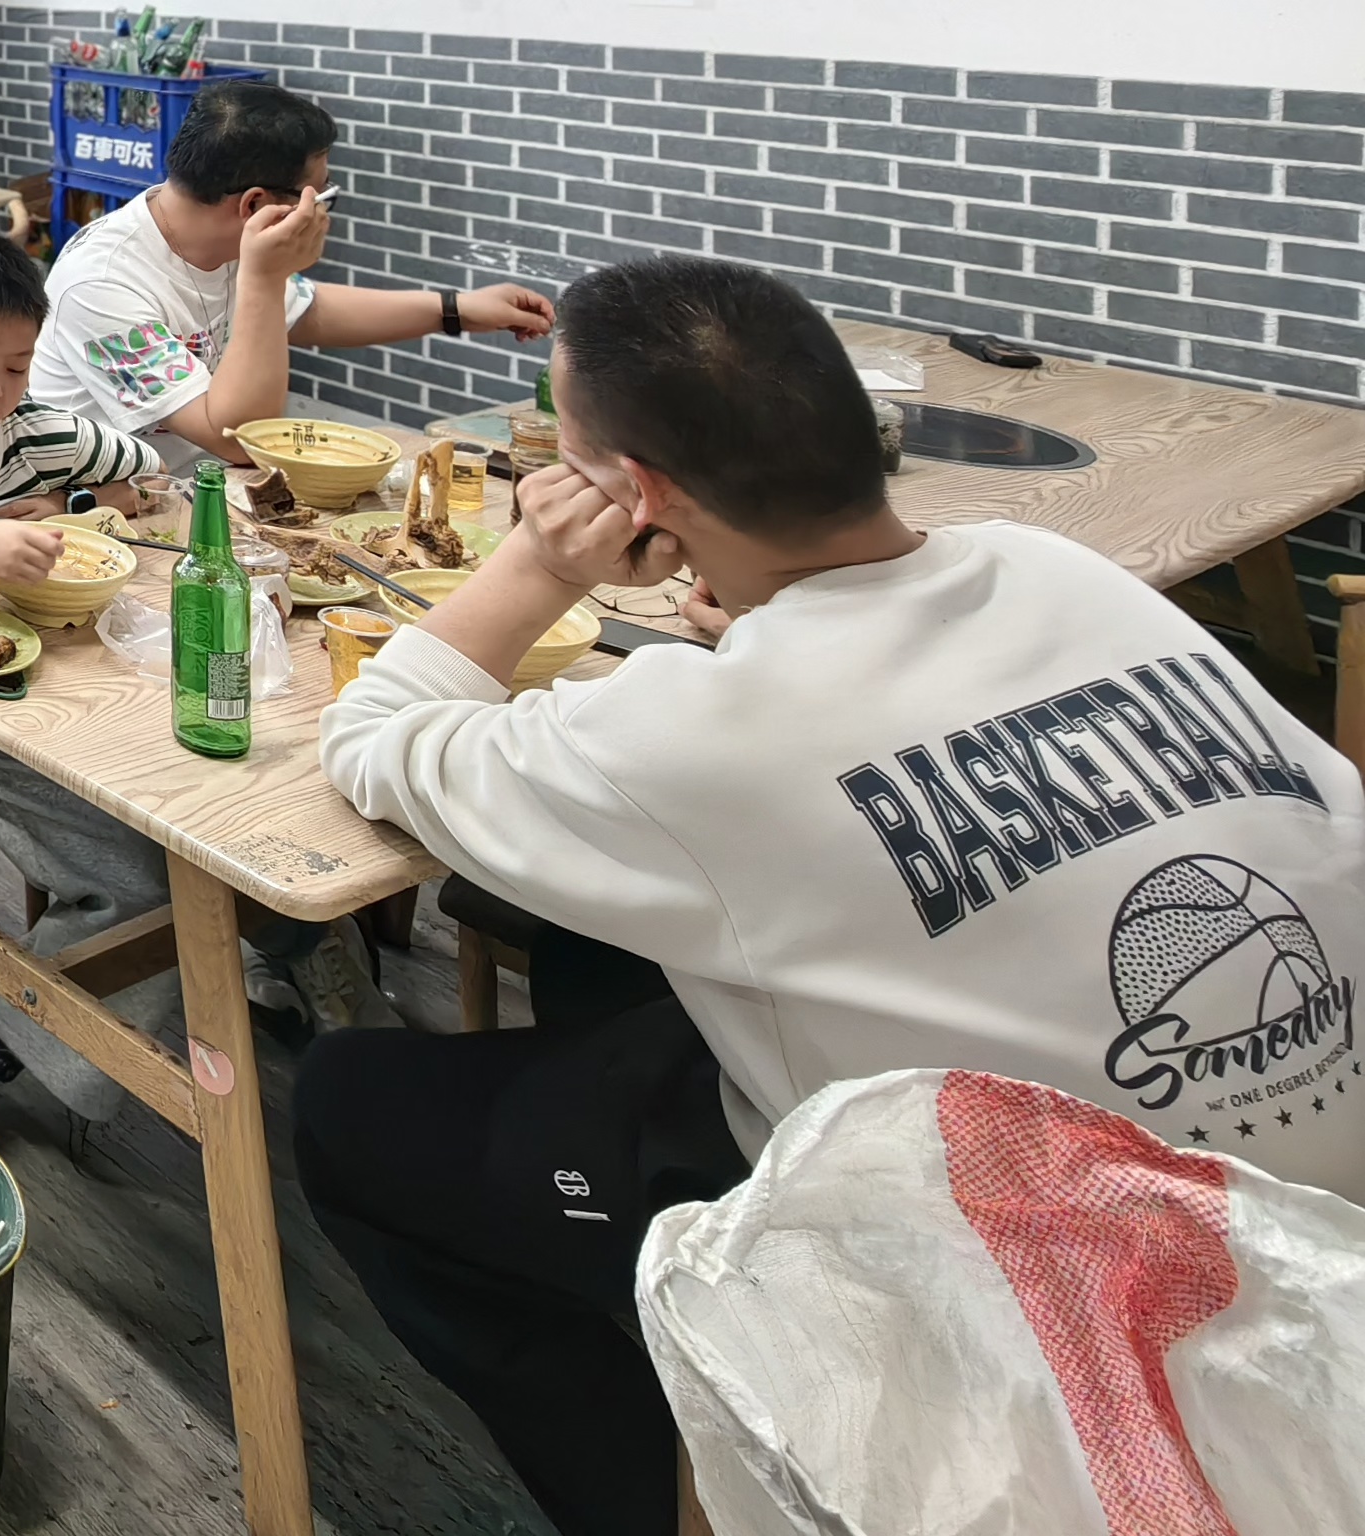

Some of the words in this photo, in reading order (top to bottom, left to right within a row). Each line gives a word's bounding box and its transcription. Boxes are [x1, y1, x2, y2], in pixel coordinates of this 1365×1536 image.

[74, 133, 154, 169] 百事可乐
[835, 652, 1330, 939] BASKETBALL
[1105, 975, 1356, 1110] Someday
[1230, 1087, 1264, 1108] ONE
